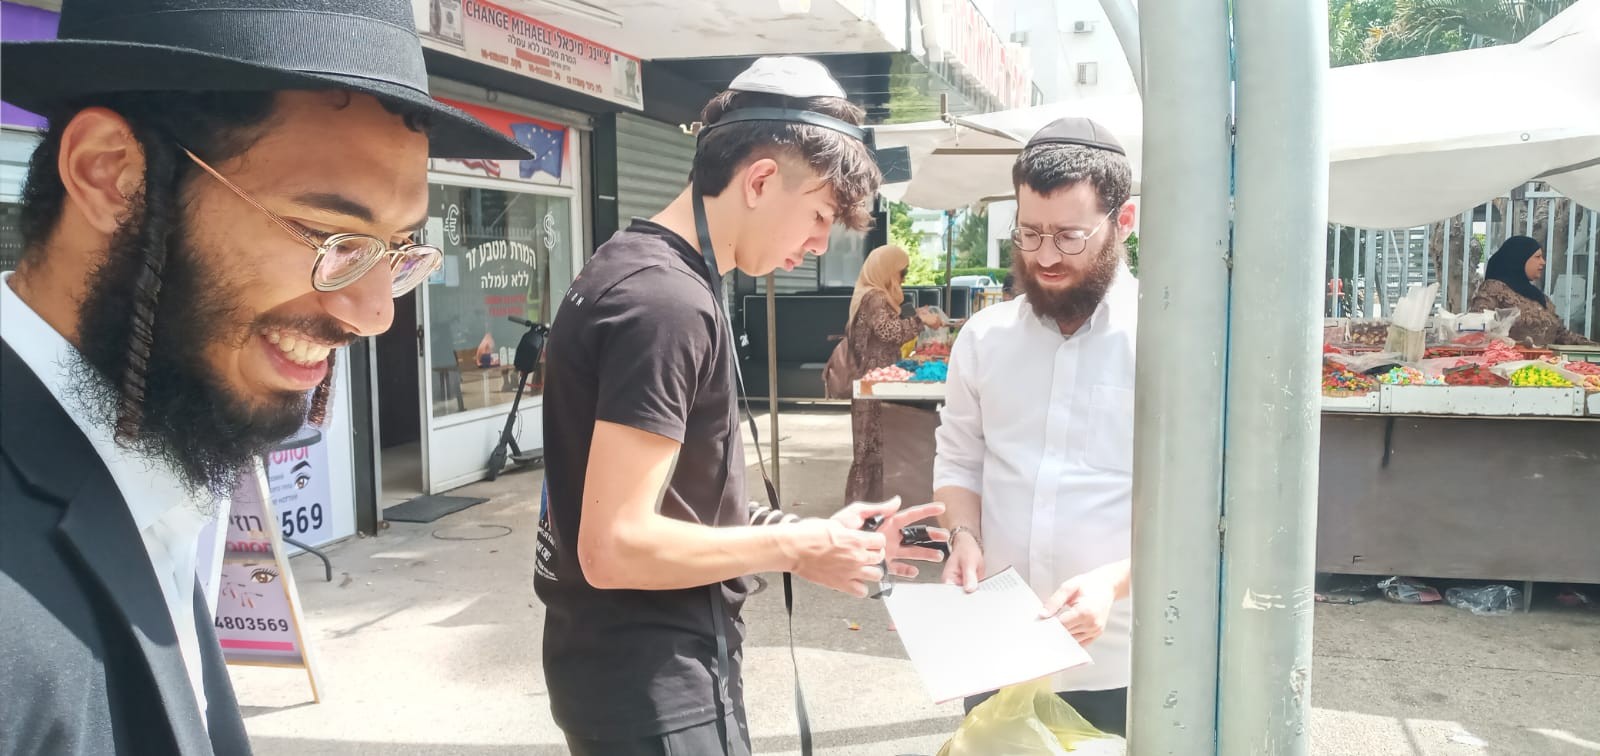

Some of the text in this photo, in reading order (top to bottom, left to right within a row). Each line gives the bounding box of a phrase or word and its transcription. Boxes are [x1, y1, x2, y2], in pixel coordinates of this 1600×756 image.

[465, 0, 552, 46] CHANGE MIHAELI
[541, 45, 560, 60] מטבע
[553, 31, 584, 56] מיכאלי
[560, 52, 577, 65] המרת
[465, 239, 537, 272] המרת מטבע זר
[480, 270, 529, 289] ללא עמלה
[279, 502, 323, 538] 569
[214, 616, 289, 632] 4803569
